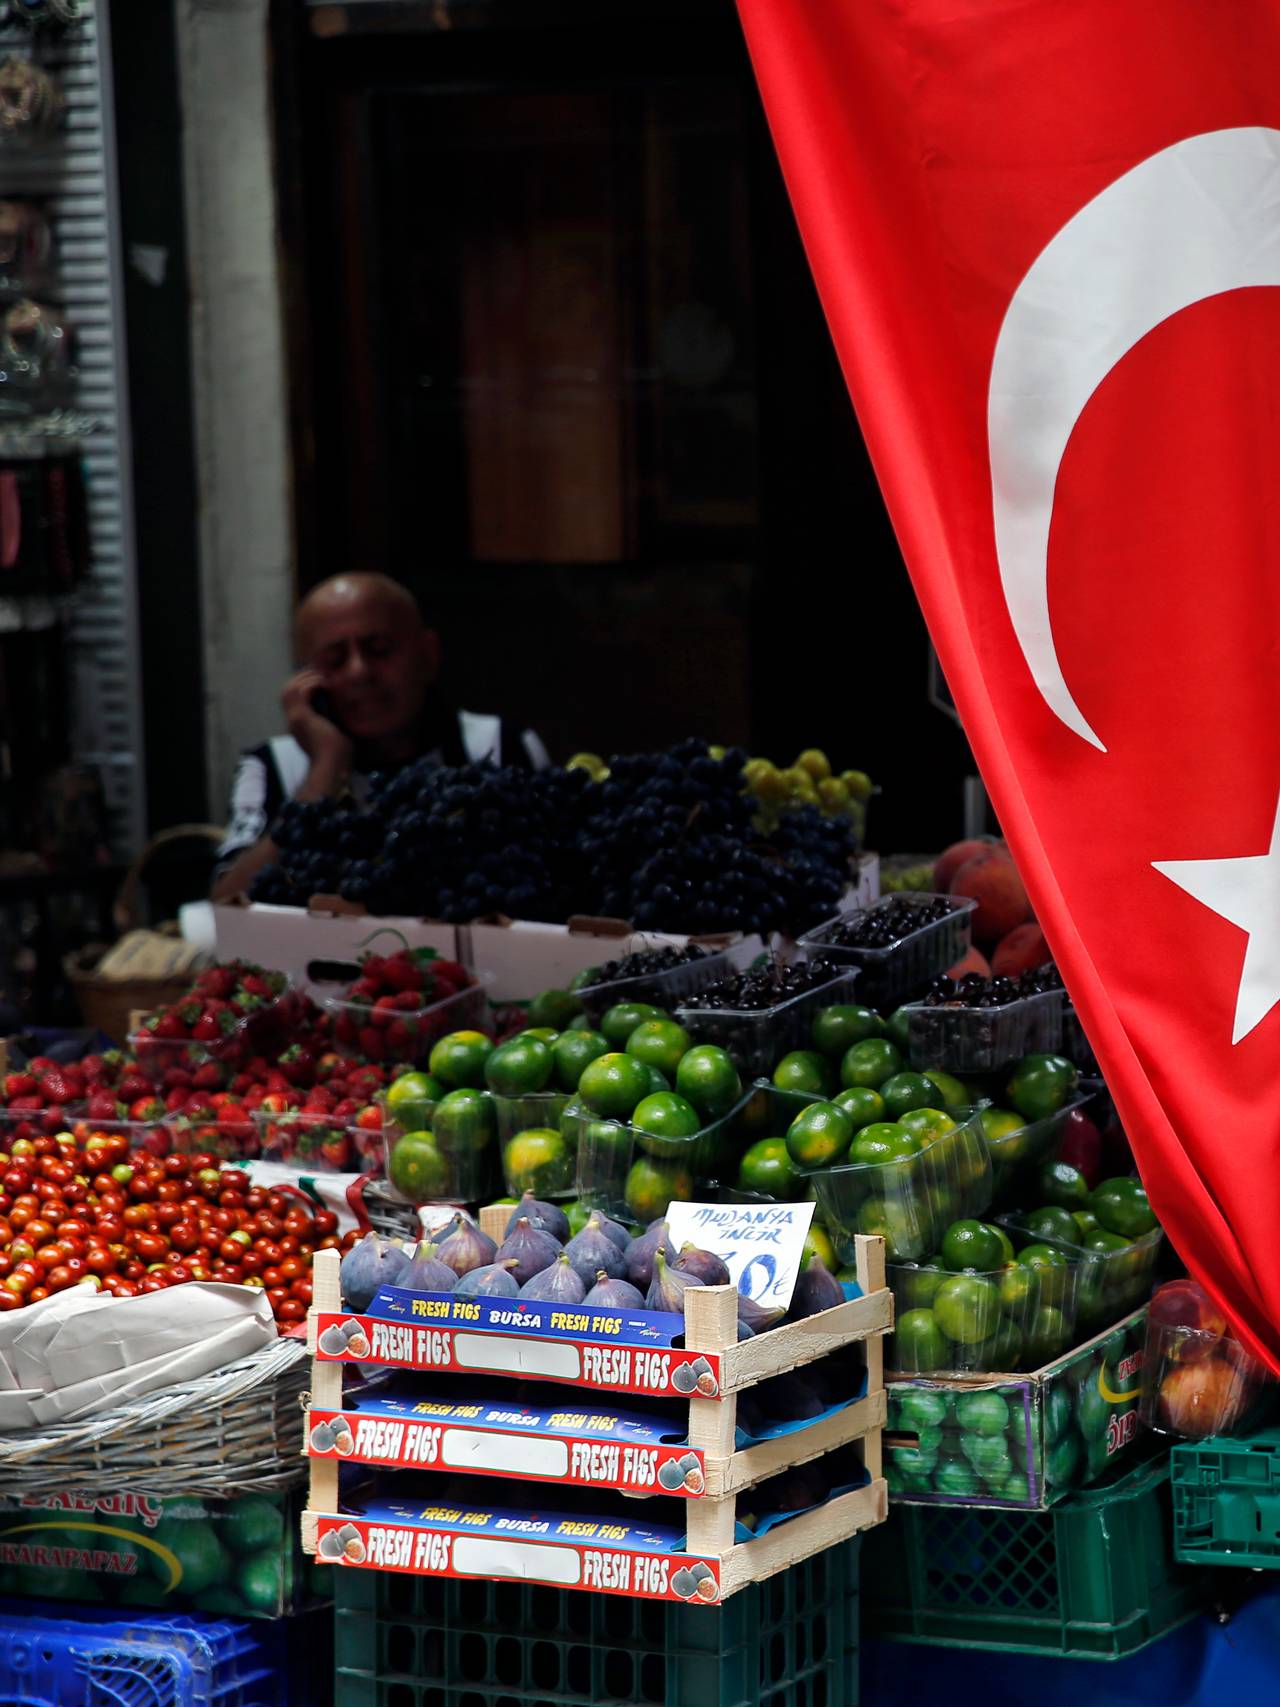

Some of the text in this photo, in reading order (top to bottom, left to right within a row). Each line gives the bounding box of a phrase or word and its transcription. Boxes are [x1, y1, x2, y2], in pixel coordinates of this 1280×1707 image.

[692, 1207, 793, 1227] MUDANYA
[411, 1299, 450, 1318] FRESH
[452, 1302, 481, 1321] FIGS
[488, 1310, 542, 1328] BURSA
[550, 1312, 590, 1332] FRESH
[592, 1316, 622, 1335] FIGS
[371, 1322, 451, 1365] FRESH FIGS
[583, 1346, 671, 1390] FRESH FIGS
[411, 1402, 452, 1416] FRESH
[451, 1405, 484, 1418] FIGS
[485, 1410, 541, 1427] BURSA
[545, 1413, 588, 1429] FRESH
[586, 1415, 619, 1431] FIGS
[354, 1419, 442, 1463] FRESH FIGS
[571, 1442, 659, 1486] FRESH FIGS
[419, 1507, 462, 1524] FRESH
[460, 1512, 493, 1526] FIGS
[495, 1518, 550, 1534] BURSA
[555, 1520, 599, 1537] FRESH
[596, 1524, 630, 1541] FIGS
[1, 1542, 138, 1576] KARAPAPAZ
[367, 1527, 451, 1570] FRESH FIGS
[583, 1550, 670, 1594] FRESH FIGS
